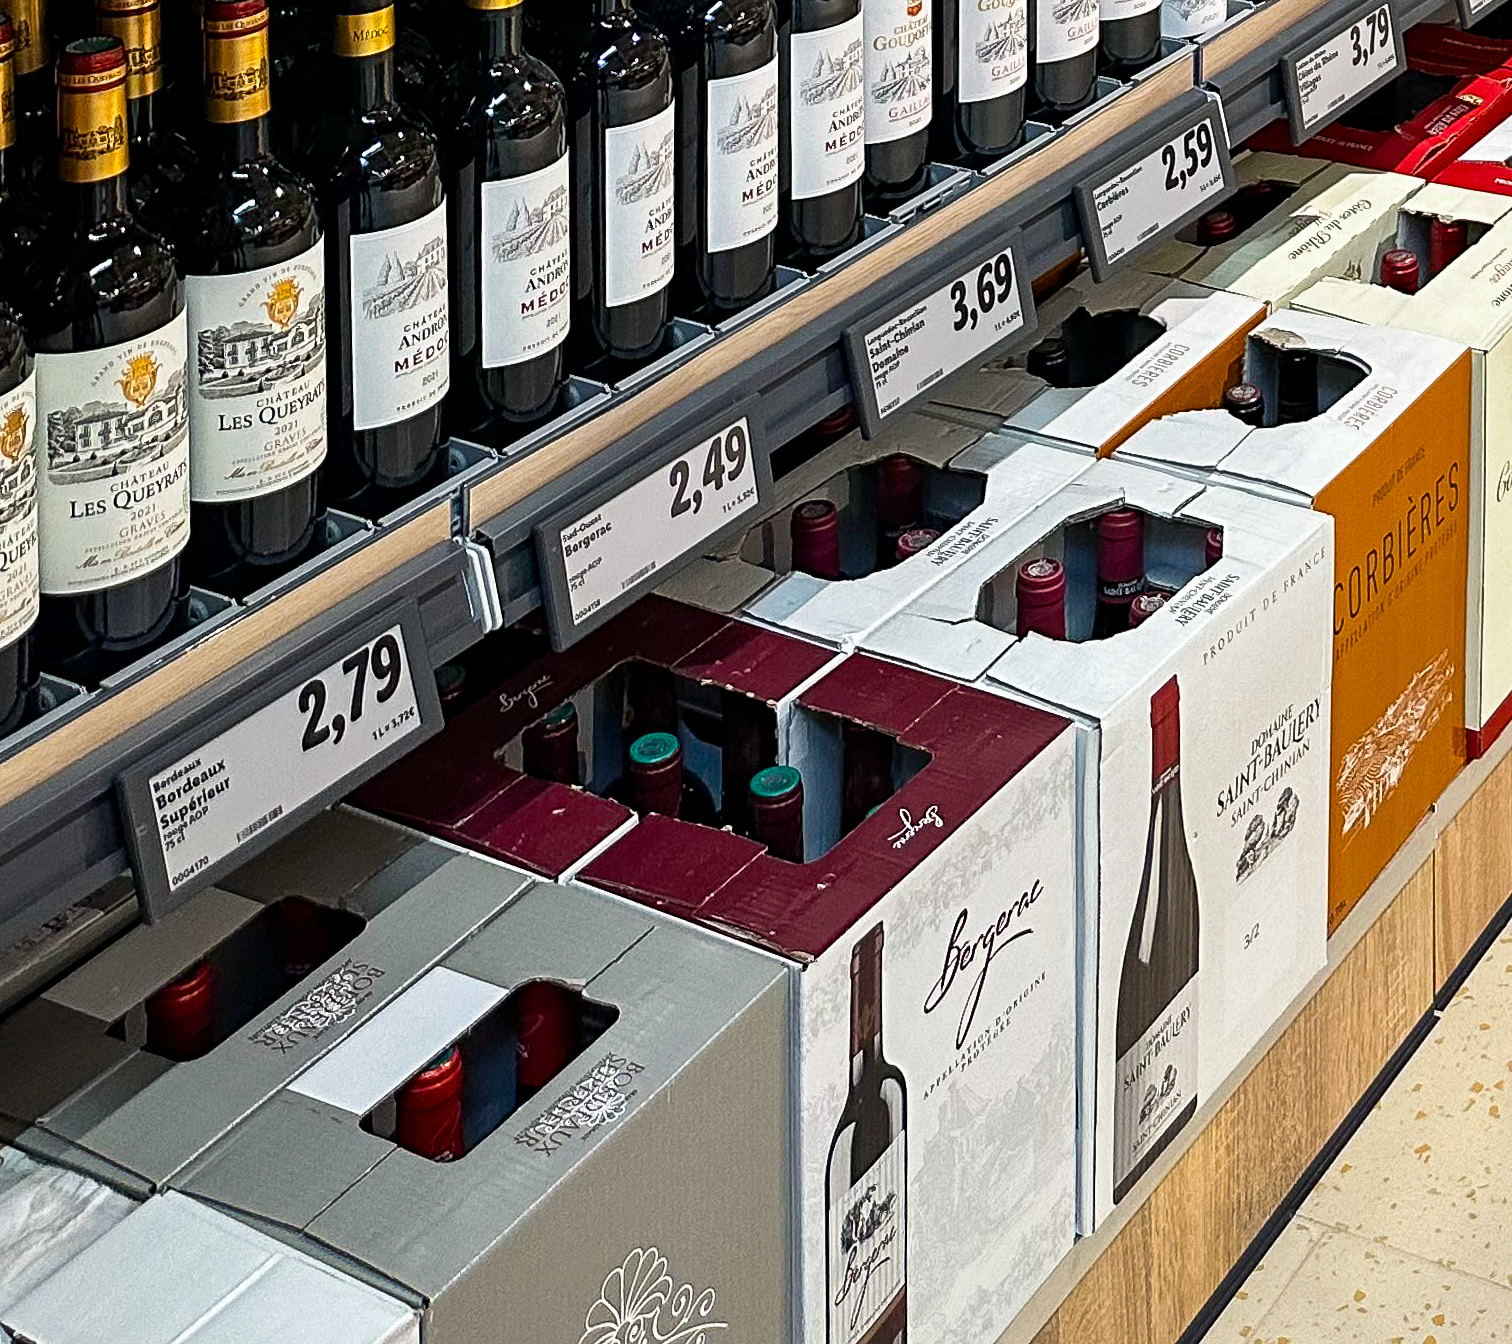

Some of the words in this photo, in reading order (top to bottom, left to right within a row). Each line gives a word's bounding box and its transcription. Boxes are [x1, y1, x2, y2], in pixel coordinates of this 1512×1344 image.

[1350, 7, 1389, 67] 3,79
[1161, 122, 1212, 191] 2,59
[951, 253, 1012, 332] 3,69
[218, 413, 252, 431] LES
[259, 381, 325, 425] QUEYRATS
[256, 381, 310, 409] CHÂTEAU
[275, 419, 299, 436] 2021
[70, 499, 107, 518] LES
[113, 461, 188, 510] QUEYRATS
[110, 460, 170, 492] CHÂTEAU
[669, 426, 746, 518] 2,49
[130, 503, 156, 522] 2021
[564, 522, 612, 557] Bergerac
[1333, 462, 1460, 637] CORBIÈRES
[1202, 609, 1256, 666] PRODUIT
[1262, 589, 1279, 610] DE
[1283, 546, 1326, 594] FRANCE
[299, 634, 401, 752] 2,79
[1216, 698, 1320, 818] SAINT-BAULERY
[1250, 703, 1294, 755] DOMAINE
[152, 758, 201, 793] Bordeaux
[155, 759, 226, 810] Bordeaux
[160, 776, 231, 829] Supérieur
[1231, 739, 1310, 826] SAINT-CHINIAN
[923, 879, 1043, 1050] Bergerac
[924, 1026, 991, 1099] APPELLATION
[1123, 1004, 1191, 1091] SAINT-BAULERY
[835, 1226, 897, 1330] Bergerac
